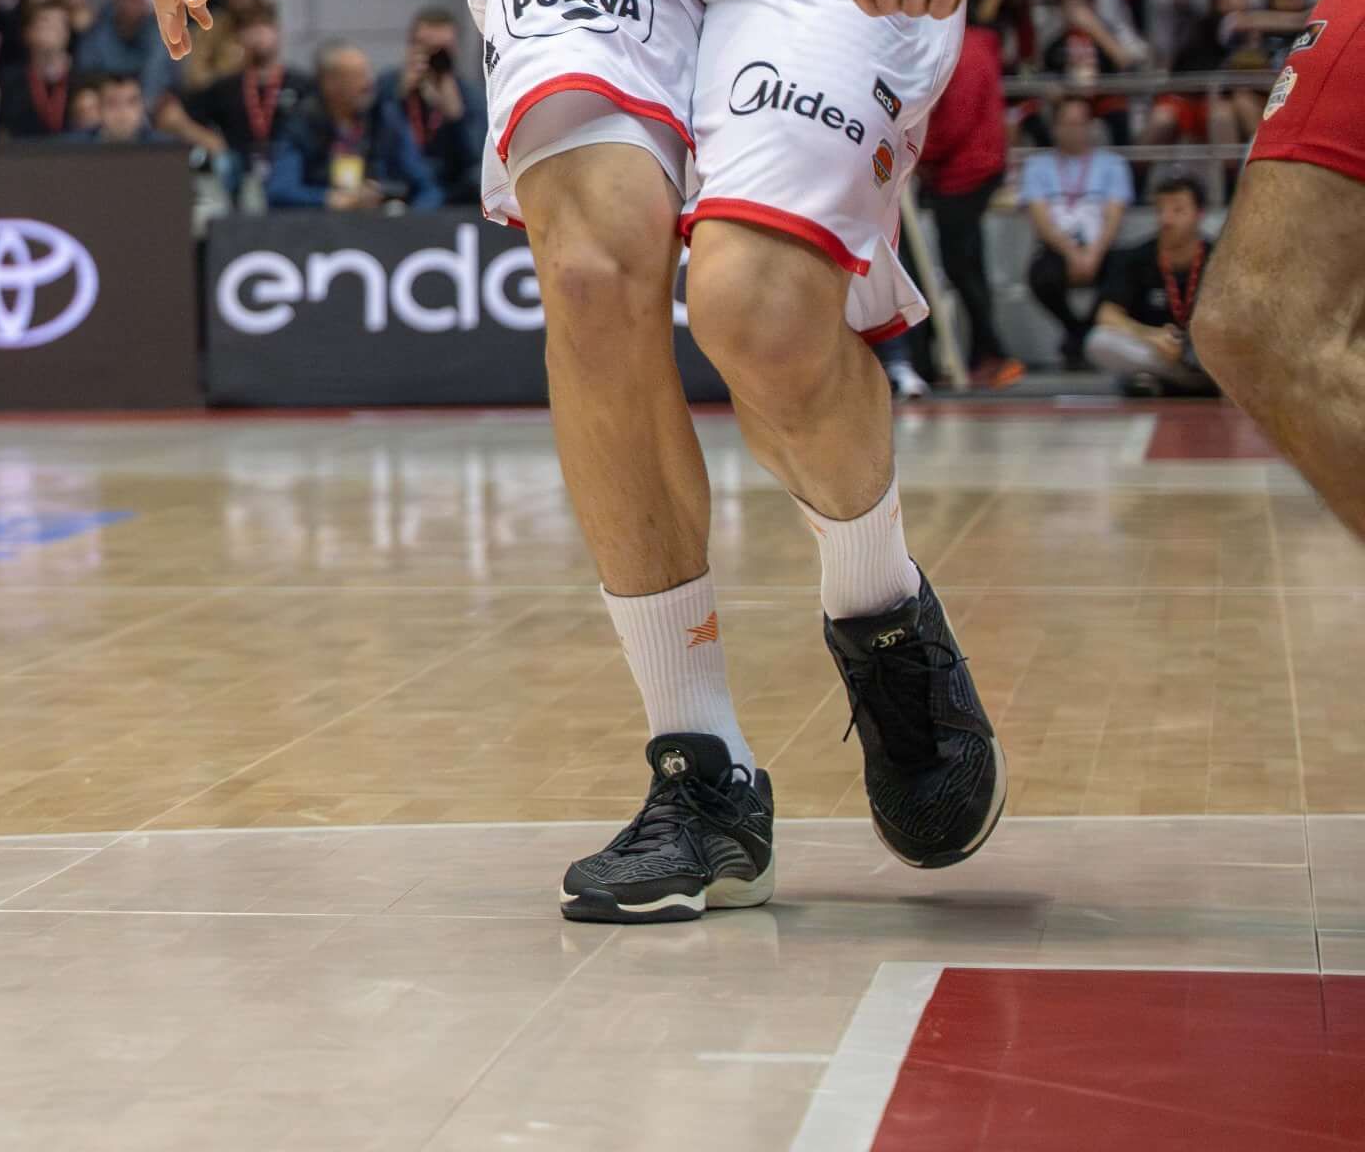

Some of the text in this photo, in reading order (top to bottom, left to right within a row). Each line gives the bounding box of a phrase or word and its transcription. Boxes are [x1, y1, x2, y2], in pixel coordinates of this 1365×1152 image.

[729, 61, 865, 145] Midea
[875, 88, 894, 113] acb
[218, 223, 689, 335] ende
